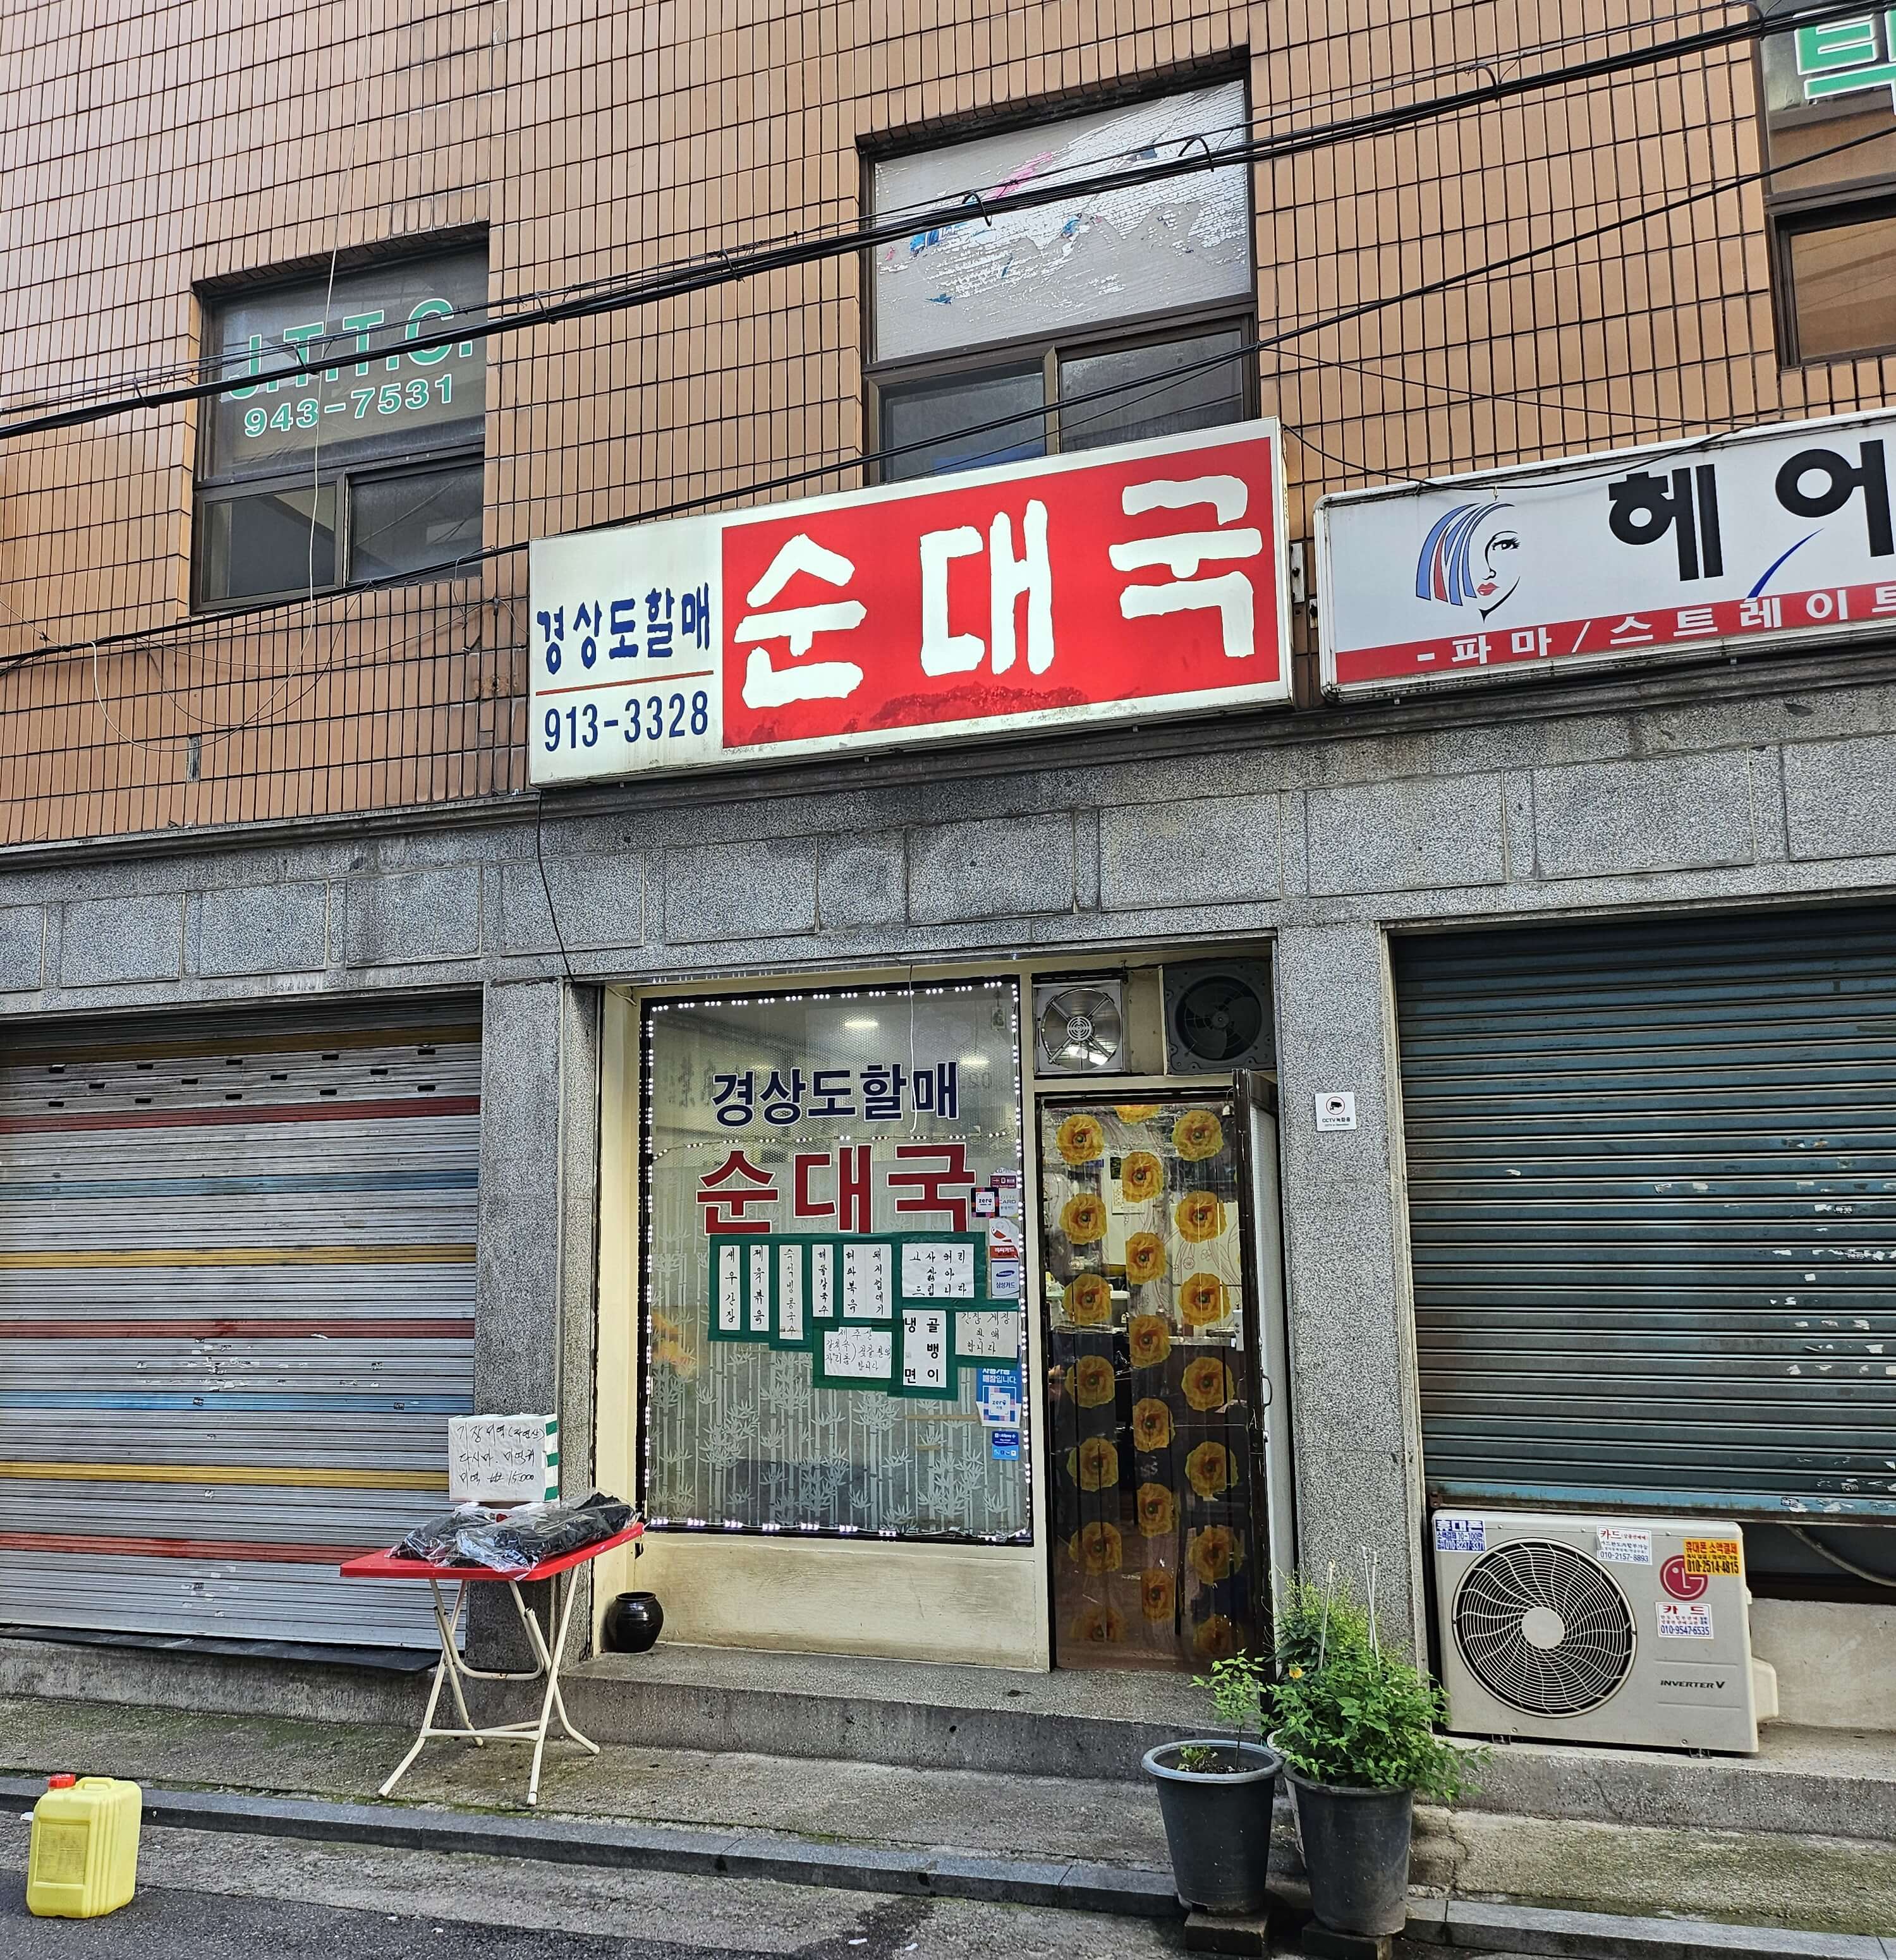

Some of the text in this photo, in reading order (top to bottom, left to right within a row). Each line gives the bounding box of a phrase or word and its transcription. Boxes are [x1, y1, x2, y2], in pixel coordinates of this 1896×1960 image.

[243, 373, 453, 438] 943-7531
[1608, 439, 1895, 582] 헤어
[734, 474, 1264, 709] 순대국
[537, 582, 710, 675] 경상도할매
[544, 690, 708, 752] 913-3328
[712, 1060, 959, 1127] 경상도할매
[696, 1142, 976, 1235] 순대국
[995, 1281, 1016, 1290] 삼성카드
[926, 1317, 940, 1382] 골뱅이
[1436, 1520, 1483, 1532] 휴대폰
[1600, 1529, 1622, 1540] 카드
[1687, 1559, 1739, 1574] 010-2514-4815
[1660, 1624, 1710, 1635] 010-9547-6535
[1660, 1680, 1714, 1689] INVERTER
